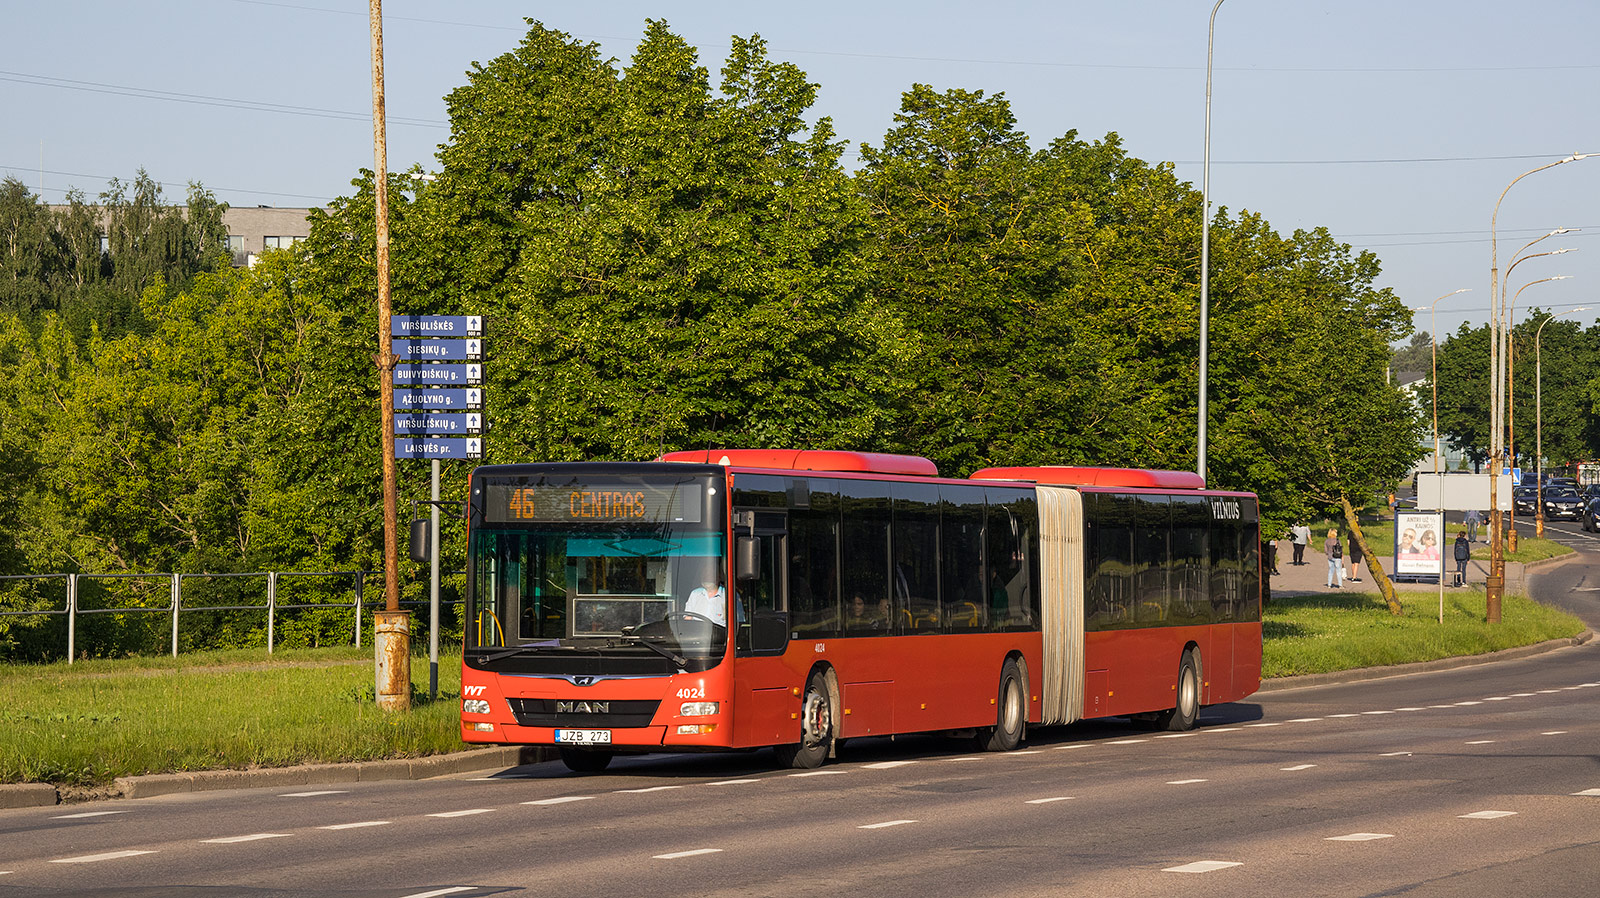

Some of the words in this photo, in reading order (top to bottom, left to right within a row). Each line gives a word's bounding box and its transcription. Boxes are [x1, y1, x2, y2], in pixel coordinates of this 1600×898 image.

[401, 320, 454, 331] VIRŠULIŠKĖS
[407, 345, 440, 356] SIESIKŲ
[441, 347, 449, 356] g.
[397, 369, 449, 381] BUIVYDIŠKIŲ
[450, 371, 459, 380] g.
[402, 394, 444, 406] ĄŽUOLYNO
[445, 396, 453, 405] g.
[397, 418, 449, 430] VIRŠULIŠKIŲ
[450, 421, 458, 430] g.
[405, 443, 439, 453] LAISVĖS
[440, 445, 451, 455] pr.
[509, 488, 535, 519] 46
[569, 491, 645, 518] CENTRAS
[1211, 501, 1240, 520] VILNIUS
[676, 687, 705, 699] 4024
[557, 701, 609, 713] MAN
[562, 731, 583, 741] JZB
[590, 731, 609, 741] 273
